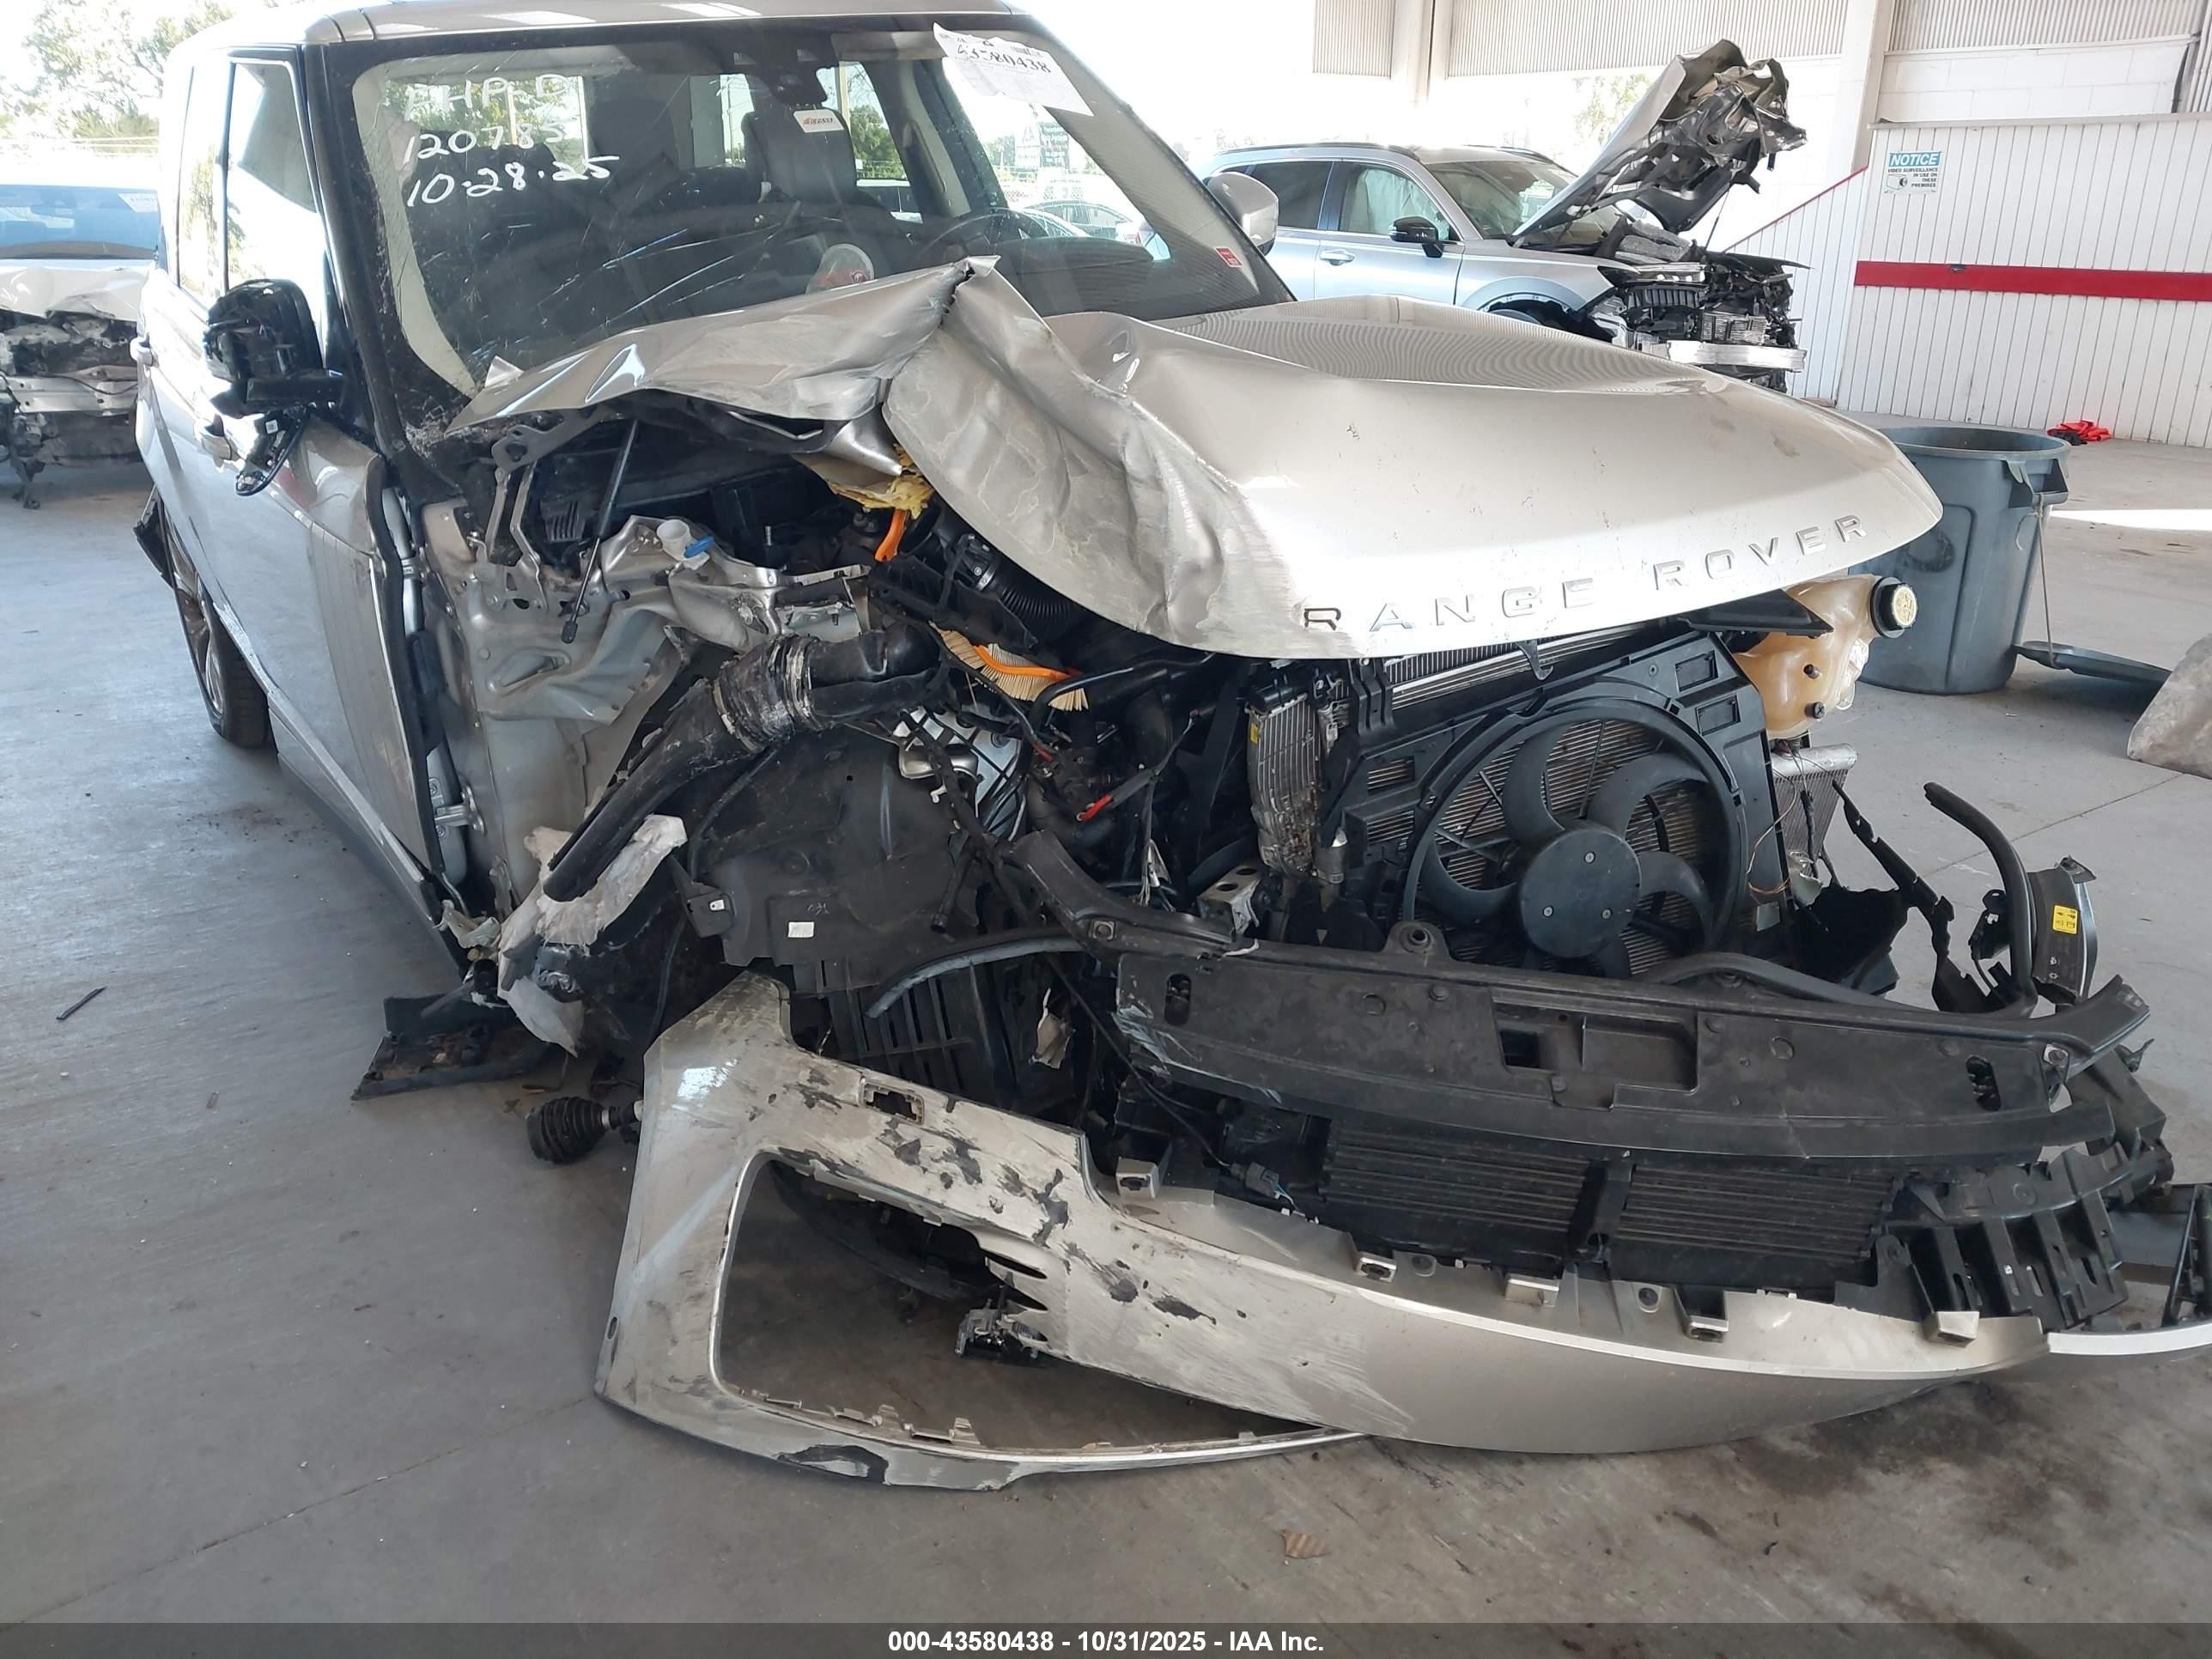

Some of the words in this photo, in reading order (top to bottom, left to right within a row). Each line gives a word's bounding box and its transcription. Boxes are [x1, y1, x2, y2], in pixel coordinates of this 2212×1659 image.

[403, 123, 565, 166] 120785
[1890, 154, 1939, 166] NOTICE
[1303, 577, 1595, 632] RANGE
[1653, 514, 1867, 591] ROVER
